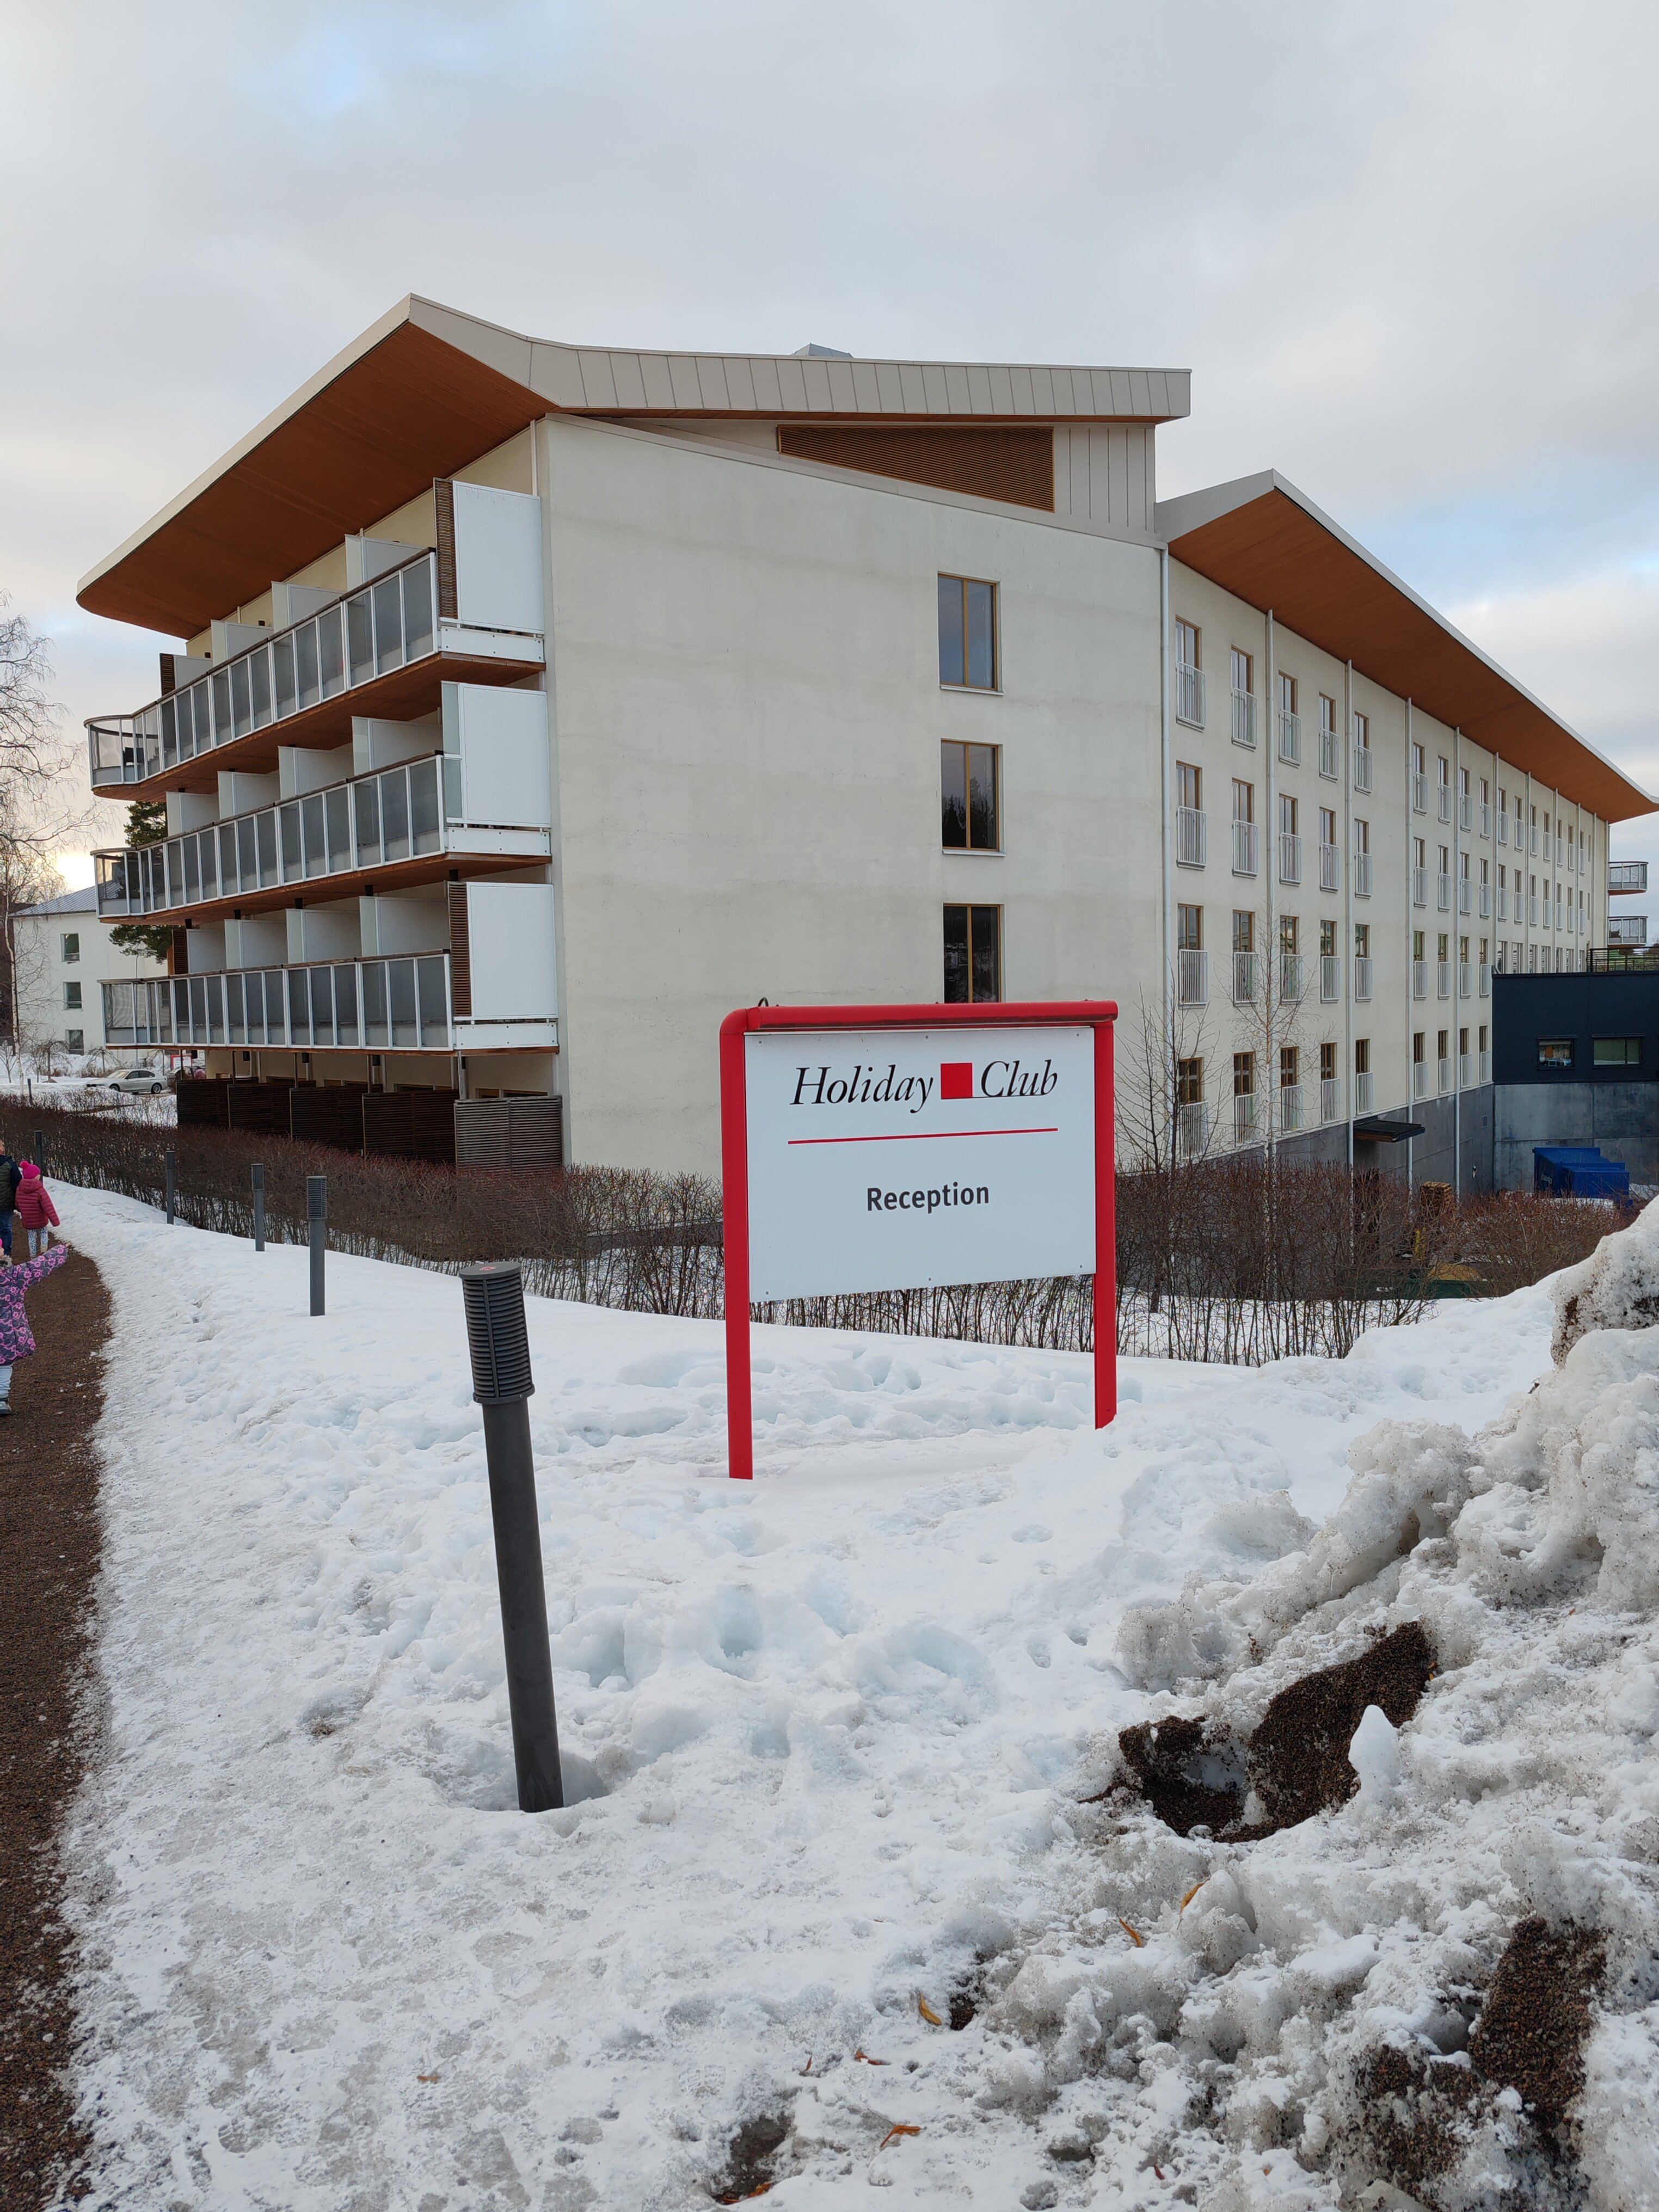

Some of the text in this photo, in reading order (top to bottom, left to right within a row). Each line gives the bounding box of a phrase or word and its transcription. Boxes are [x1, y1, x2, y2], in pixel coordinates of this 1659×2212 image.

[789, 1059, 1058, 1114] Holiday Club
[867, 1181, 990, 1214] Reception
